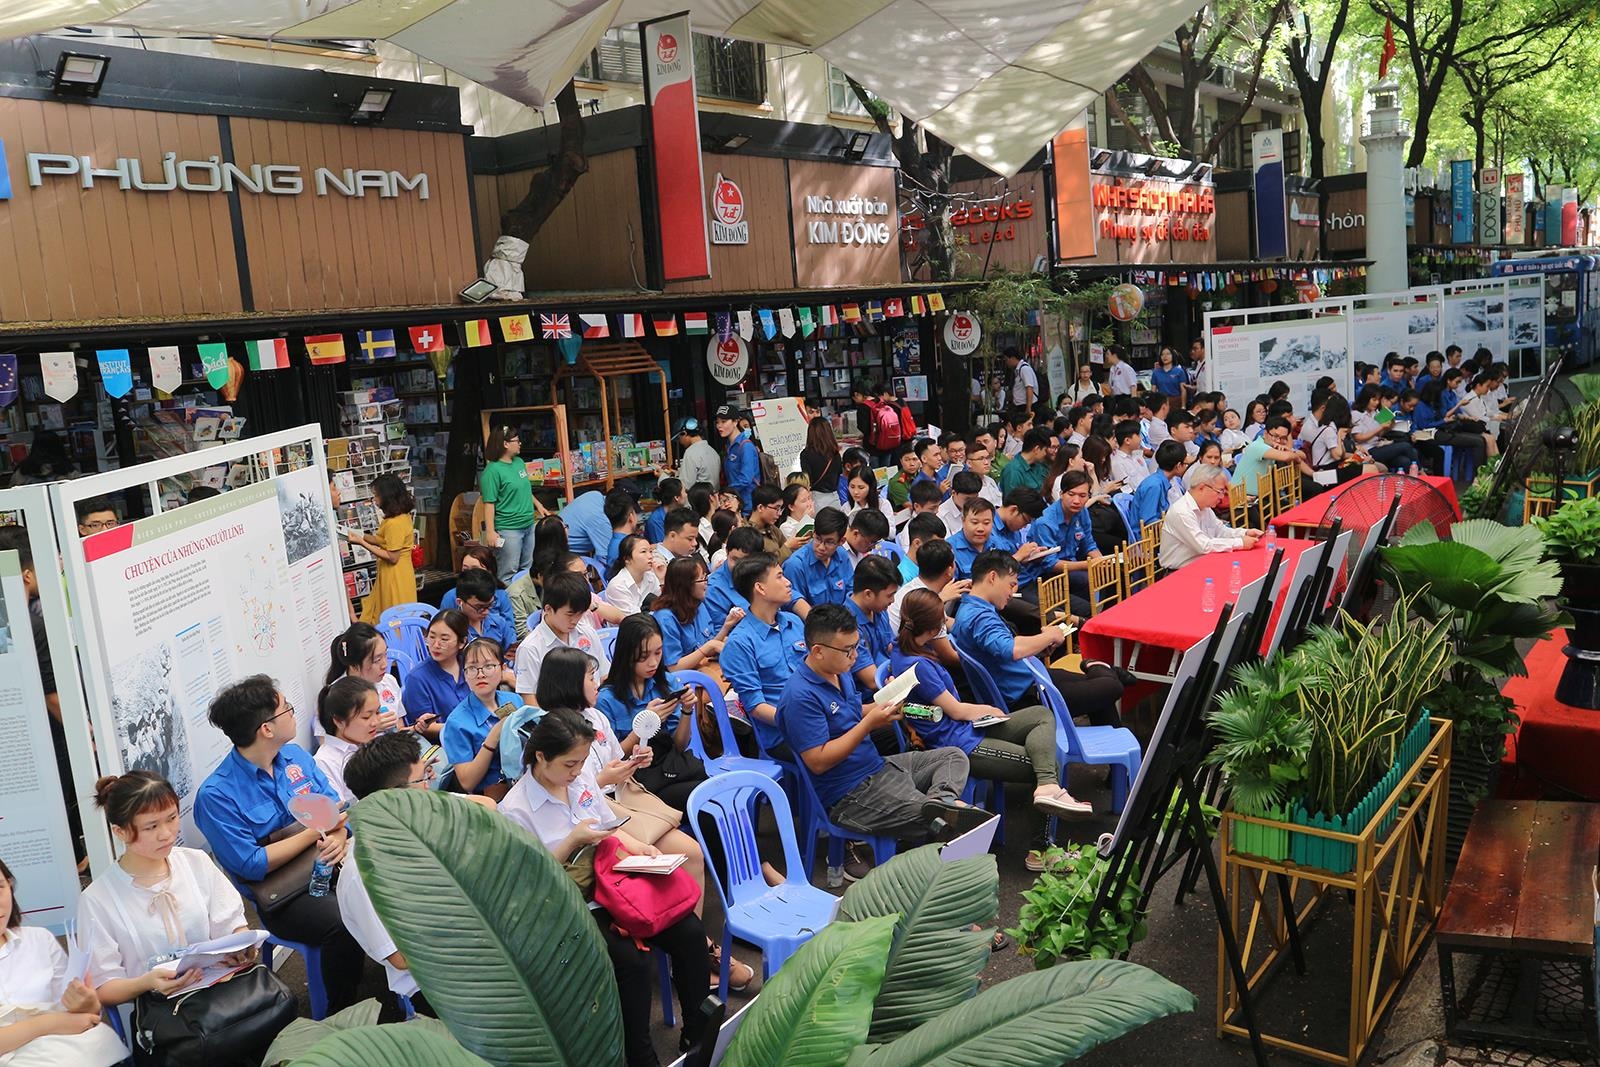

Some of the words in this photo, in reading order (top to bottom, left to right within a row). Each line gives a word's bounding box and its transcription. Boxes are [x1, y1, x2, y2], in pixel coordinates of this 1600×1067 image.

[27, 151, 303, 194] PHƯƠNG
[314, 167, 429, 200] NAM
[807, 195, 833, 214] Nhà
[836, 194, 863, 216] xuất
[865, 196, 888, 216] bản
[808, 221, 838, 244] KIM
[841, 216, 890, 244] ĐỒNG
[1326, 208, 1365, 230] hồn
[714, 223, 728, 242] KIM
[970, 223, 1016, 245] Lead
[713, 363, 725, 378] KIM
[124, 555, 161, 580] CHUYỆN
[161, 548, 179, 567] CỦA
[177, 538, 206, 562] NHỮNG
